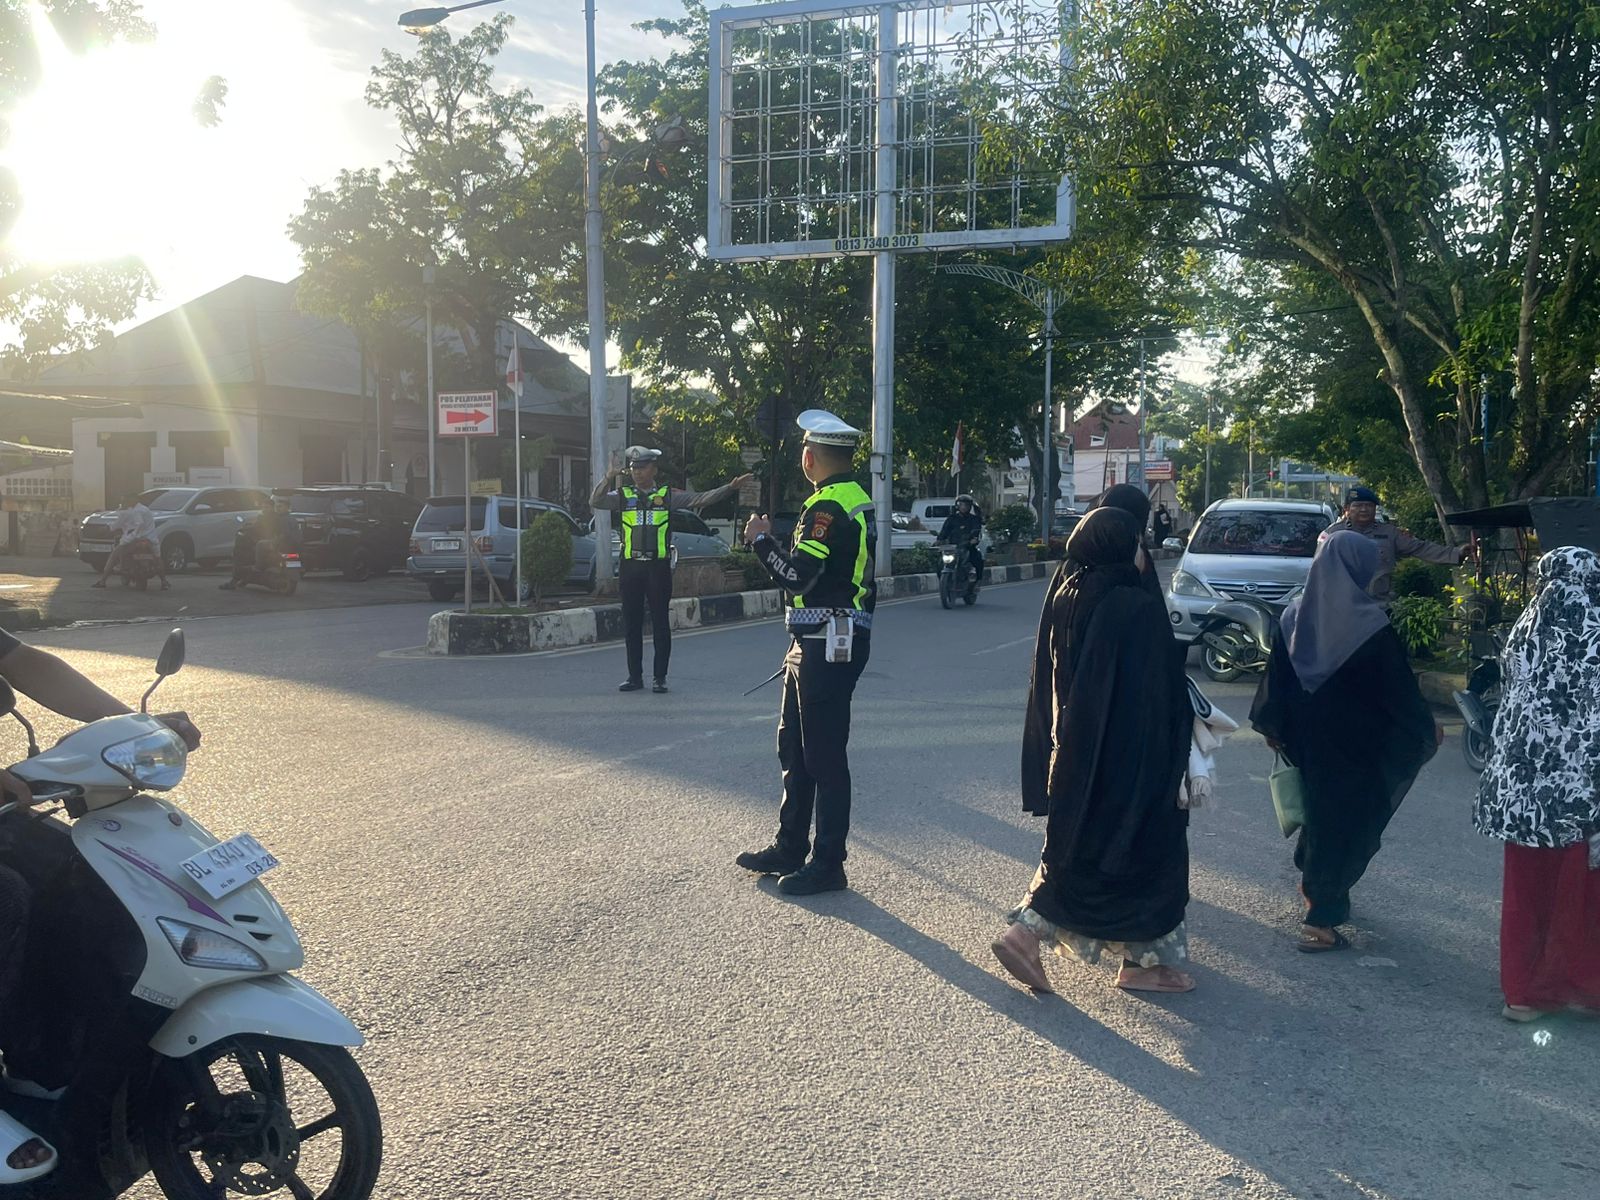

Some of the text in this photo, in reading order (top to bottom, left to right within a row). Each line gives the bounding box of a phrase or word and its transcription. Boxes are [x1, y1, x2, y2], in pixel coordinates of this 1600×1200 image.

[835, 235, 919, 251] 0813 7340 3073
[182, 860, 212, 880] BL
[207, 842, 245, 869] 4340
